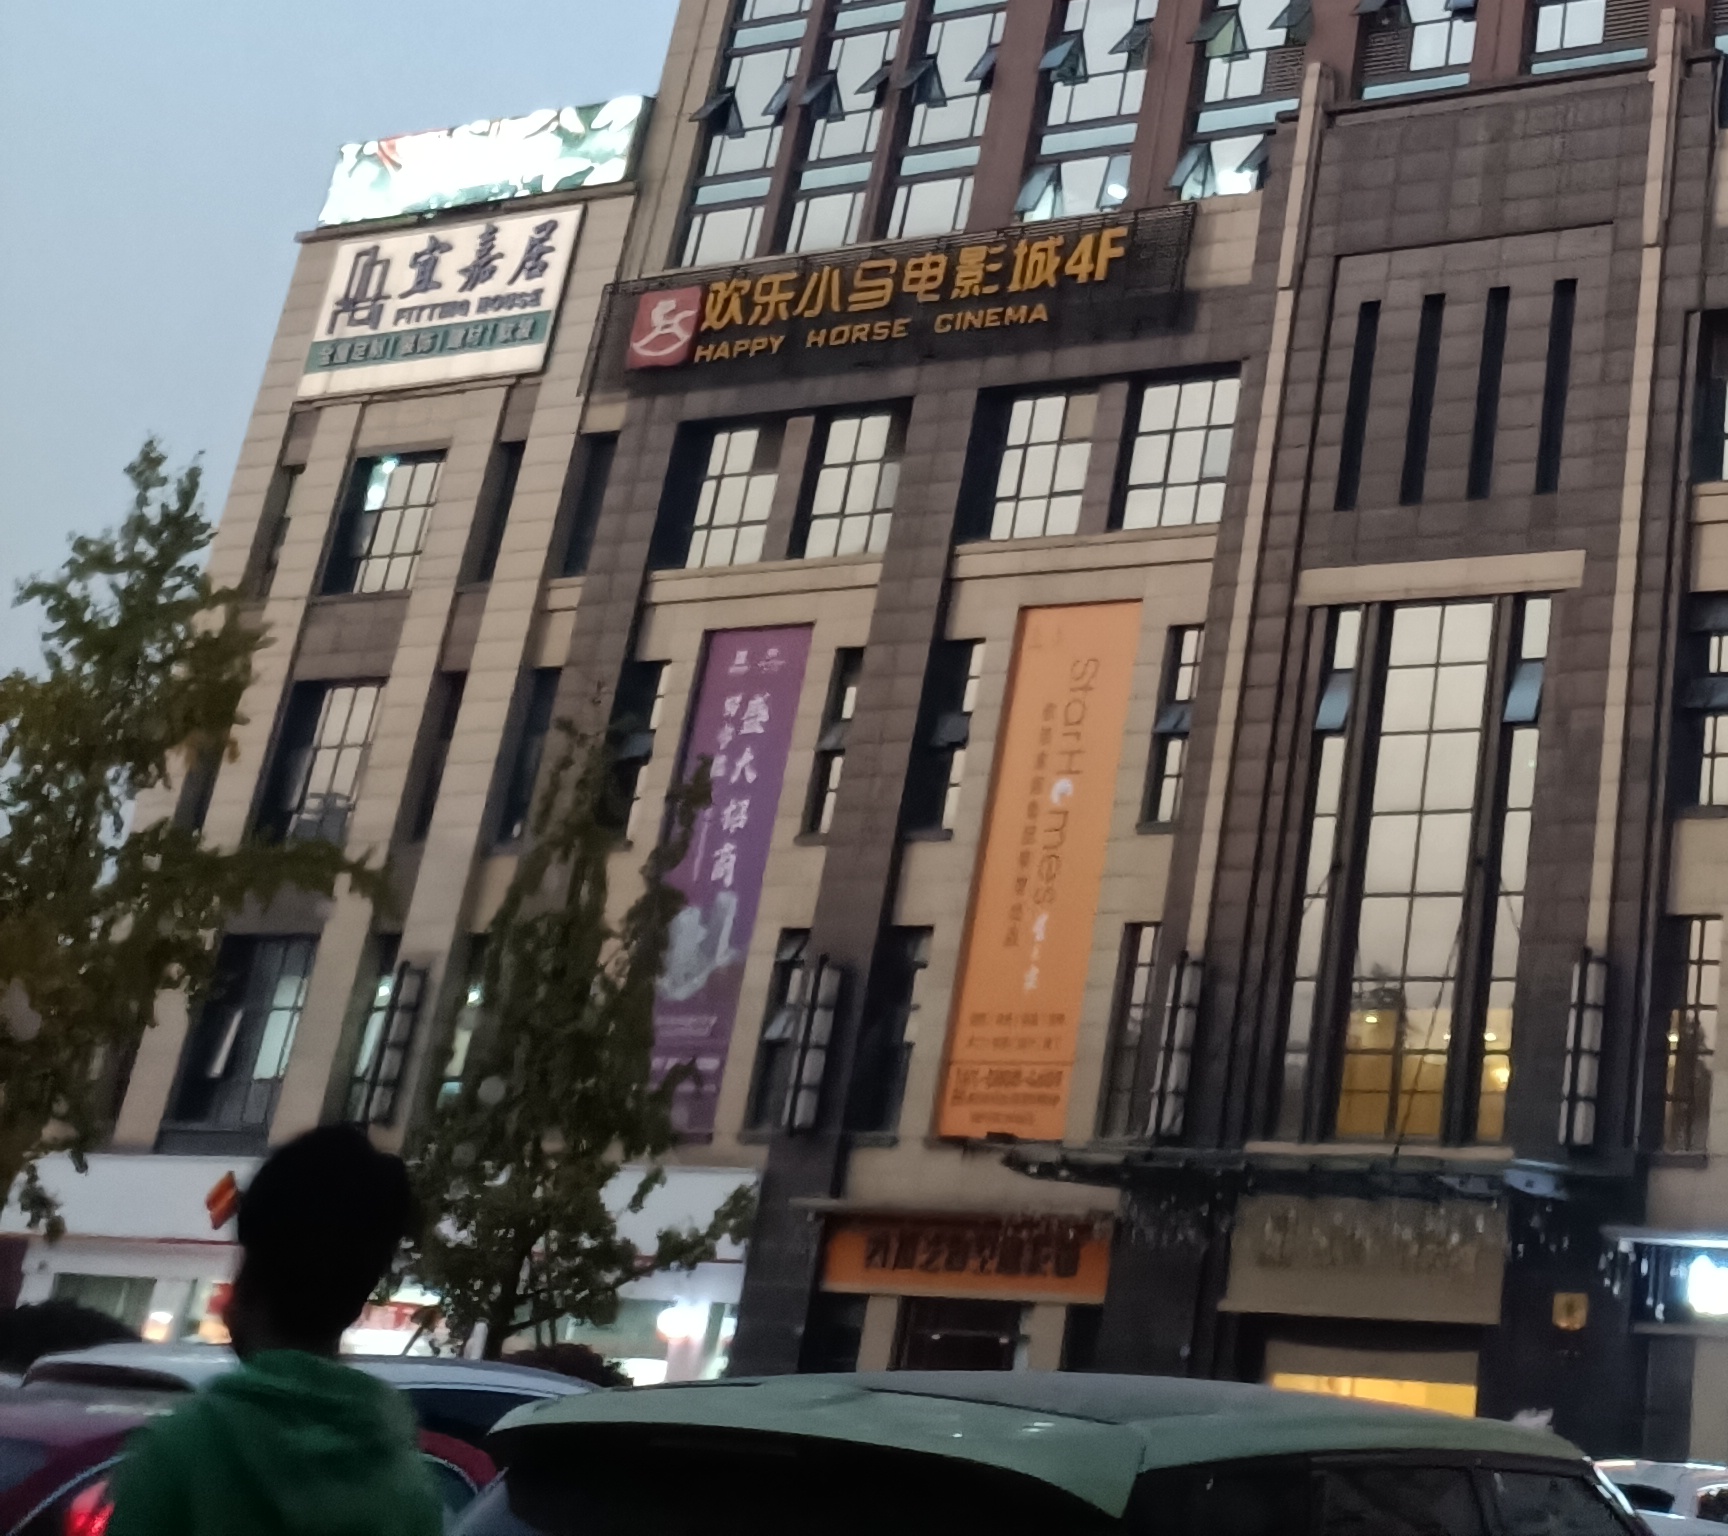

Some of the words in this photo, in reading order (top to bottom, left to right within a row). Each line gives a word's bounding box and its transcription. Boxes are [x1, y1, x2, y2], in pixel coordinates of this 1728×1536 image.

[398, 219, 558, 299] 宜嘉居
[700, 226, 1128, 333] 欢乐小马电影城4F
[694, 335, 785, 363] HAPPY
[805, 318, 912, 348] HORSE
[934, 303, 1048, 333] CINEMA
